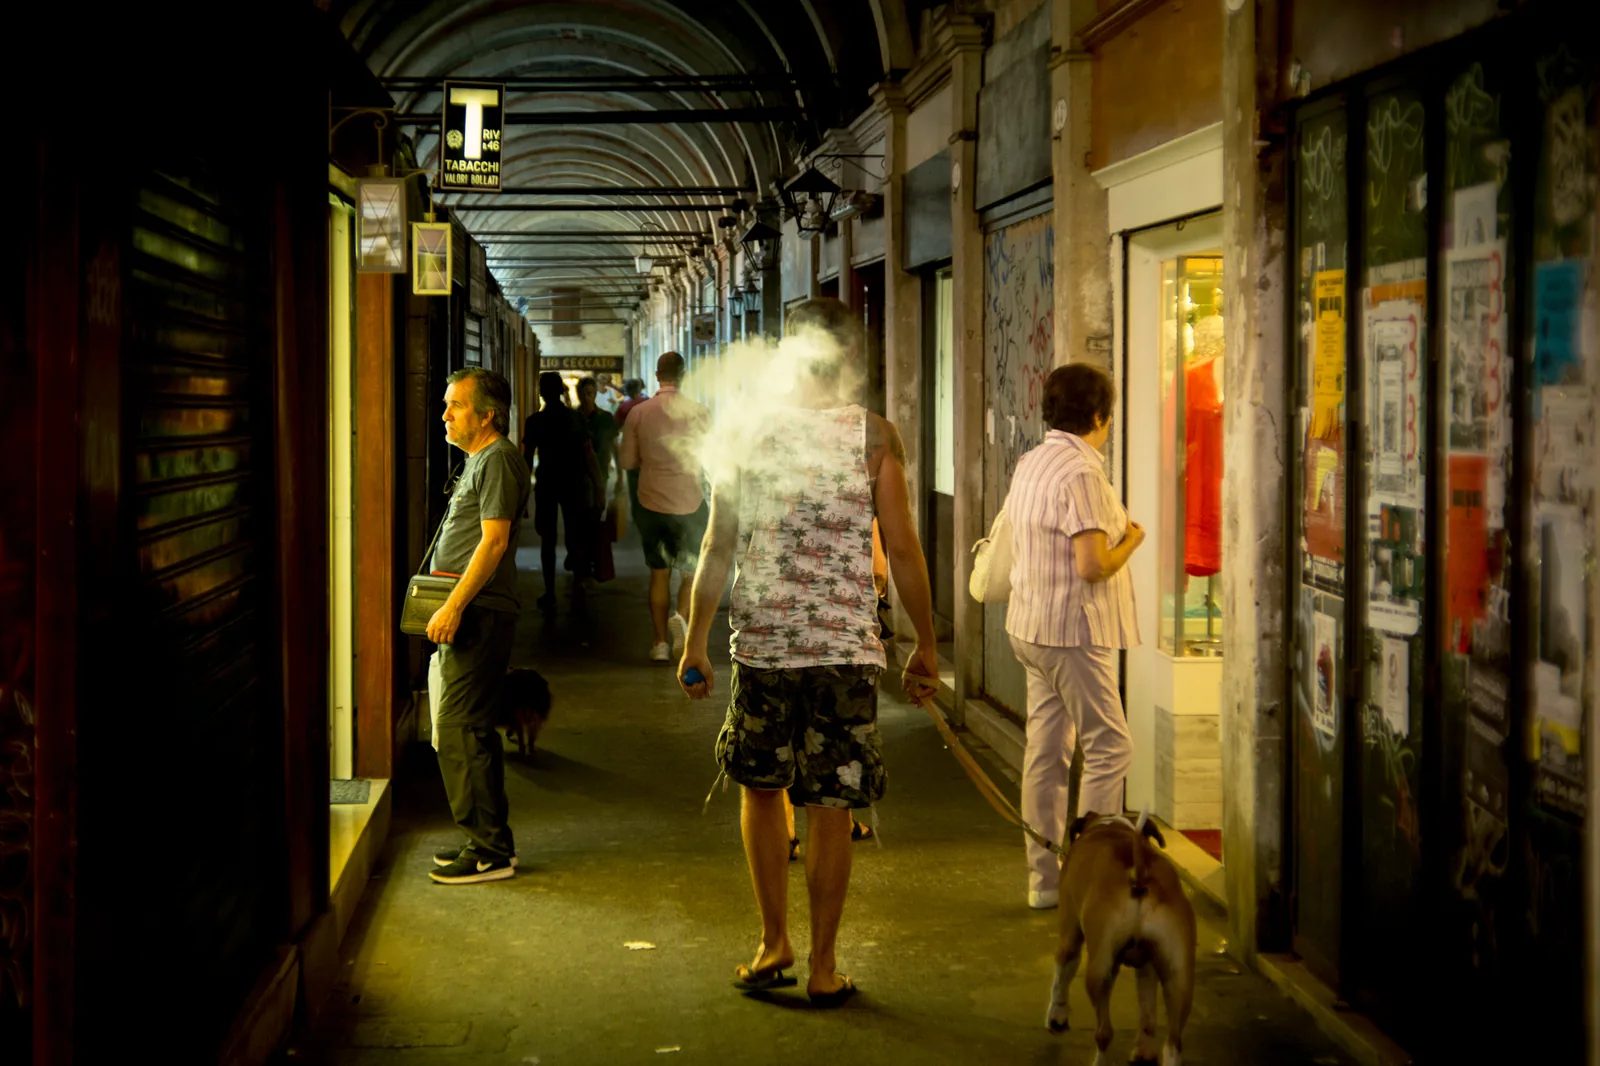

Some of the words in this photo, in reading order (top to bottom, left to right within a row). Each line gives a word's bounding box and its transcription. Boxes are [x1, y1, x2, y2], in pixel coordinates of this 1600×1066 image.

[450, 88, 498, 159] T
[445, 159, 499, 173] TABACCHI
[445, 173, 468, 184] VALORI
[470, 174, 499, 185] BOLLATI
